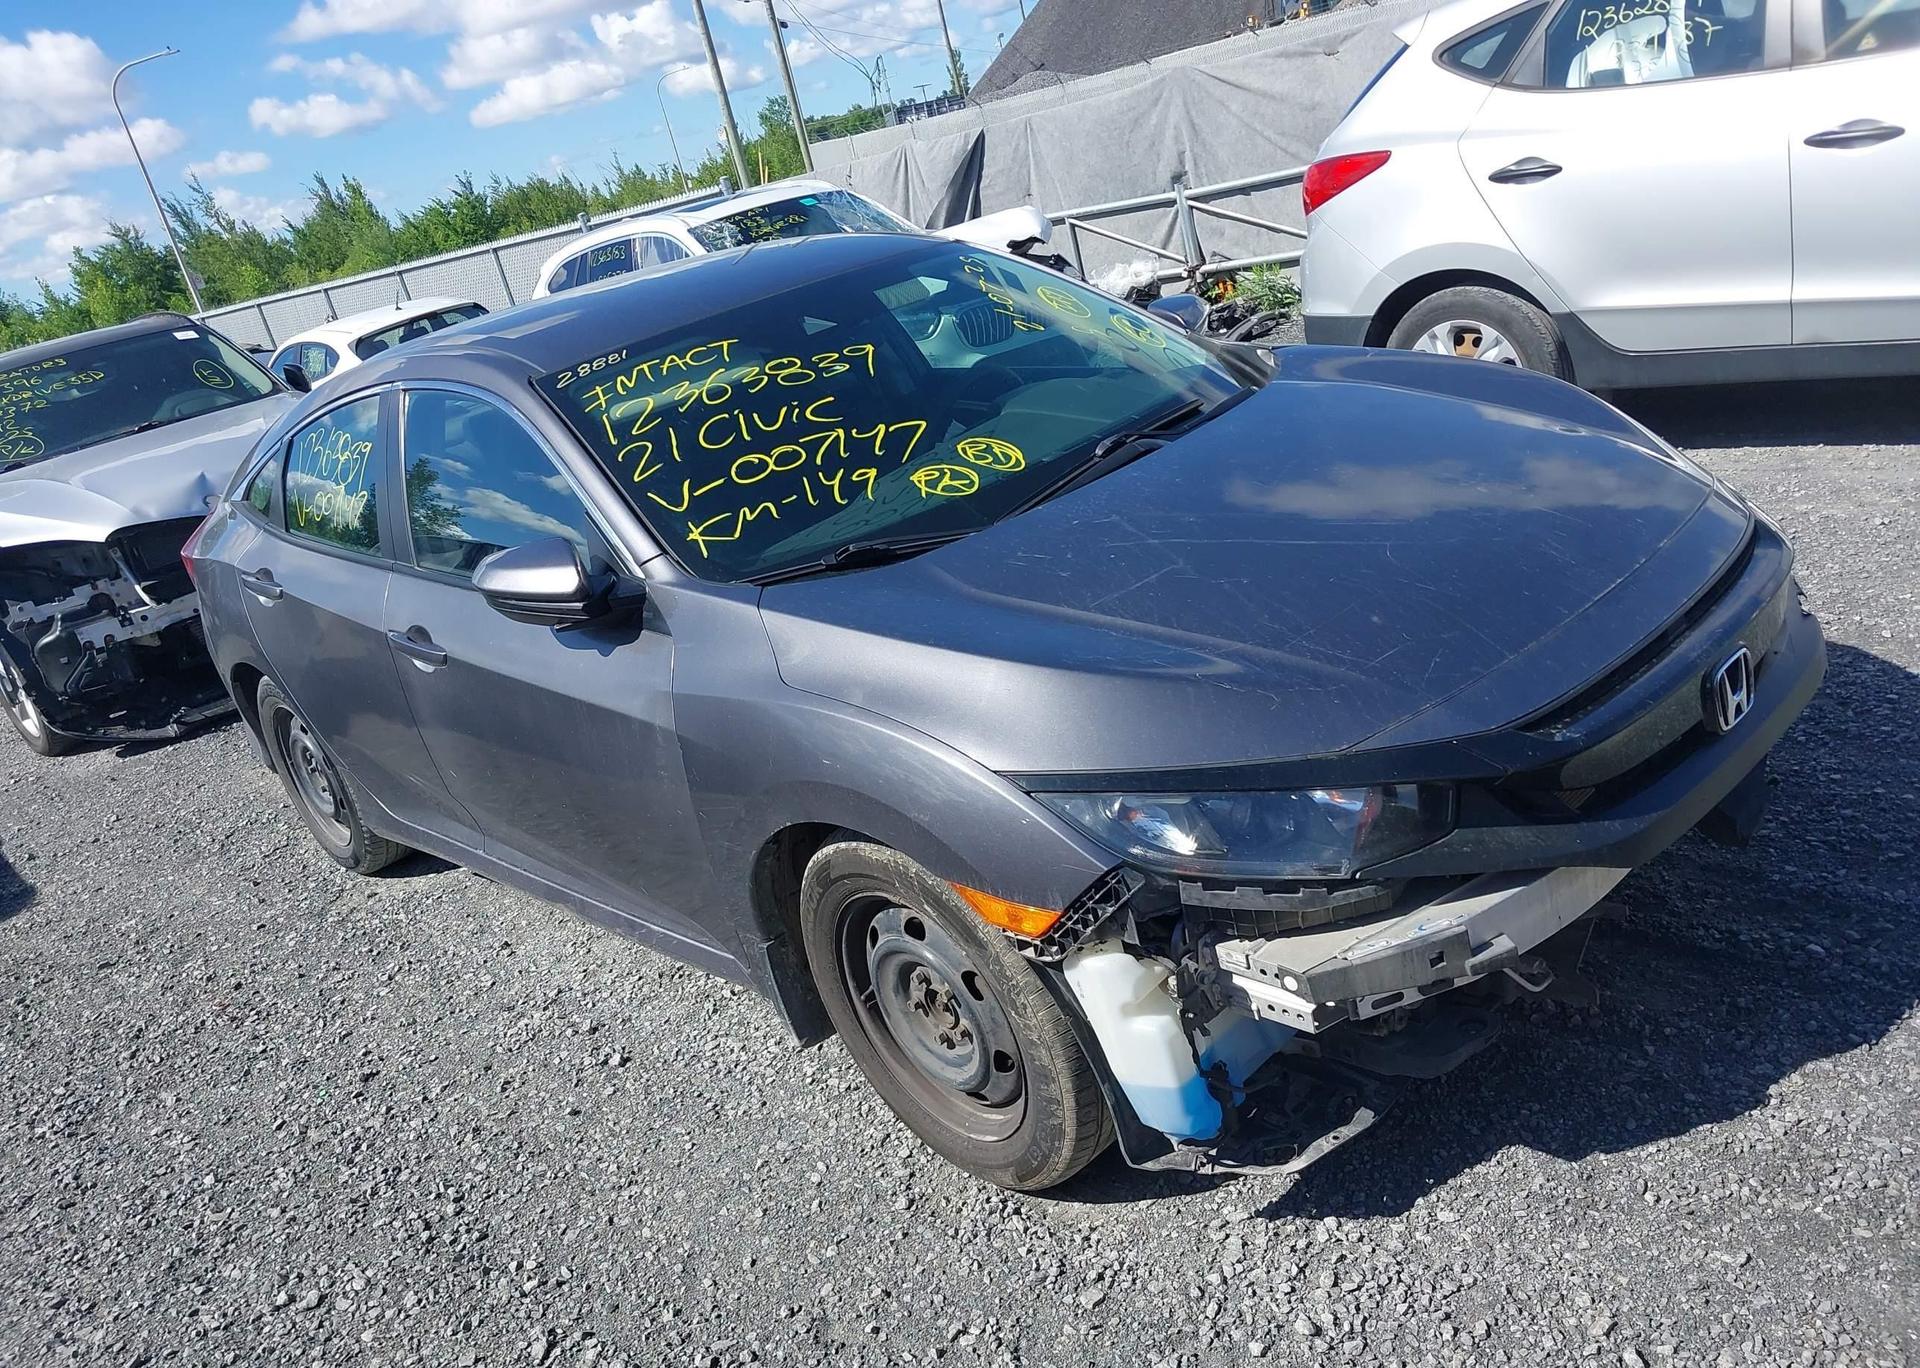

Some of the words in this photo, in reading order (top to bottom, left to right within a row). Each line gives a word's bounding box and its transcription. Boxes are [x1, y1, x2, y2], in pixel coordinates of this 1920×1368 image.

[556, 349, 627, 389] 28881
[581, 339, 739, 413] INTACT
[602, 344, 876, 446] 12363839
[617, 426, 683, 482] 21
[646, 420, 928, 512] V-007147
[686, 467, 879, 559] KM-149
